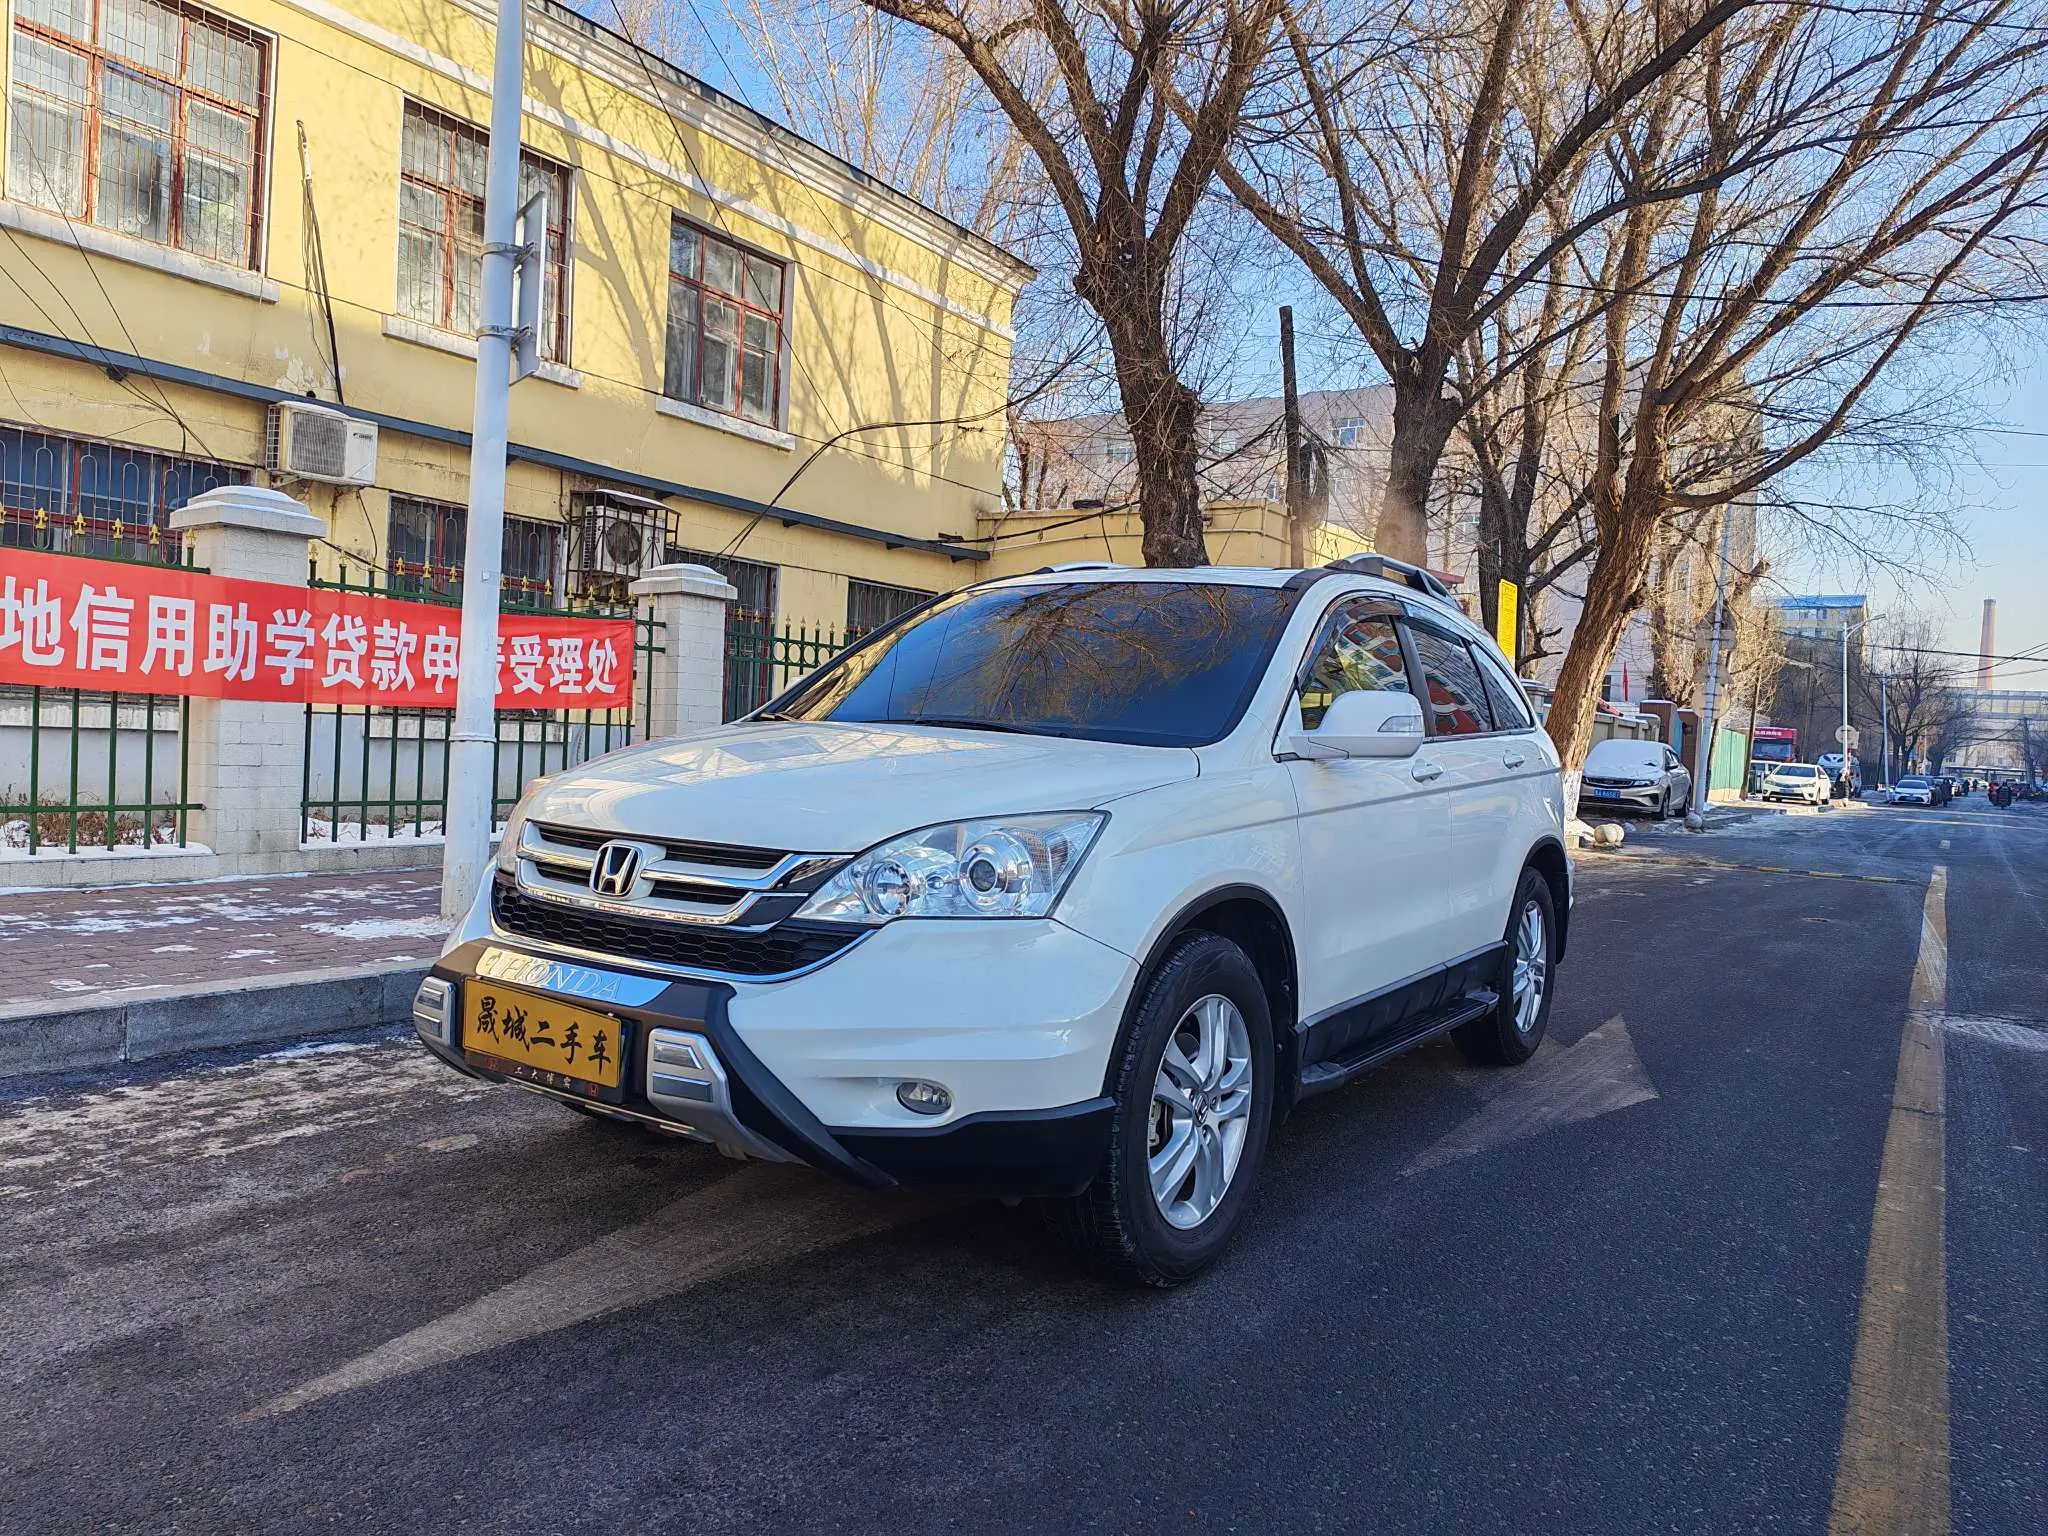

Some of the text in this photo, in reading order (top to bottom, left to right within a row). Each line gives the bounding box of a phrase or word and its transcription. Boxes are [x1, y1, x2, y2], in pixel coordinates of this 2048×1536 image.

[0, 576, 618, 694] 地信用助学贷款申受理处
[500, 956, 622, 1001] HONDA
[476, 996, 612, 1075] 晟城二手车
